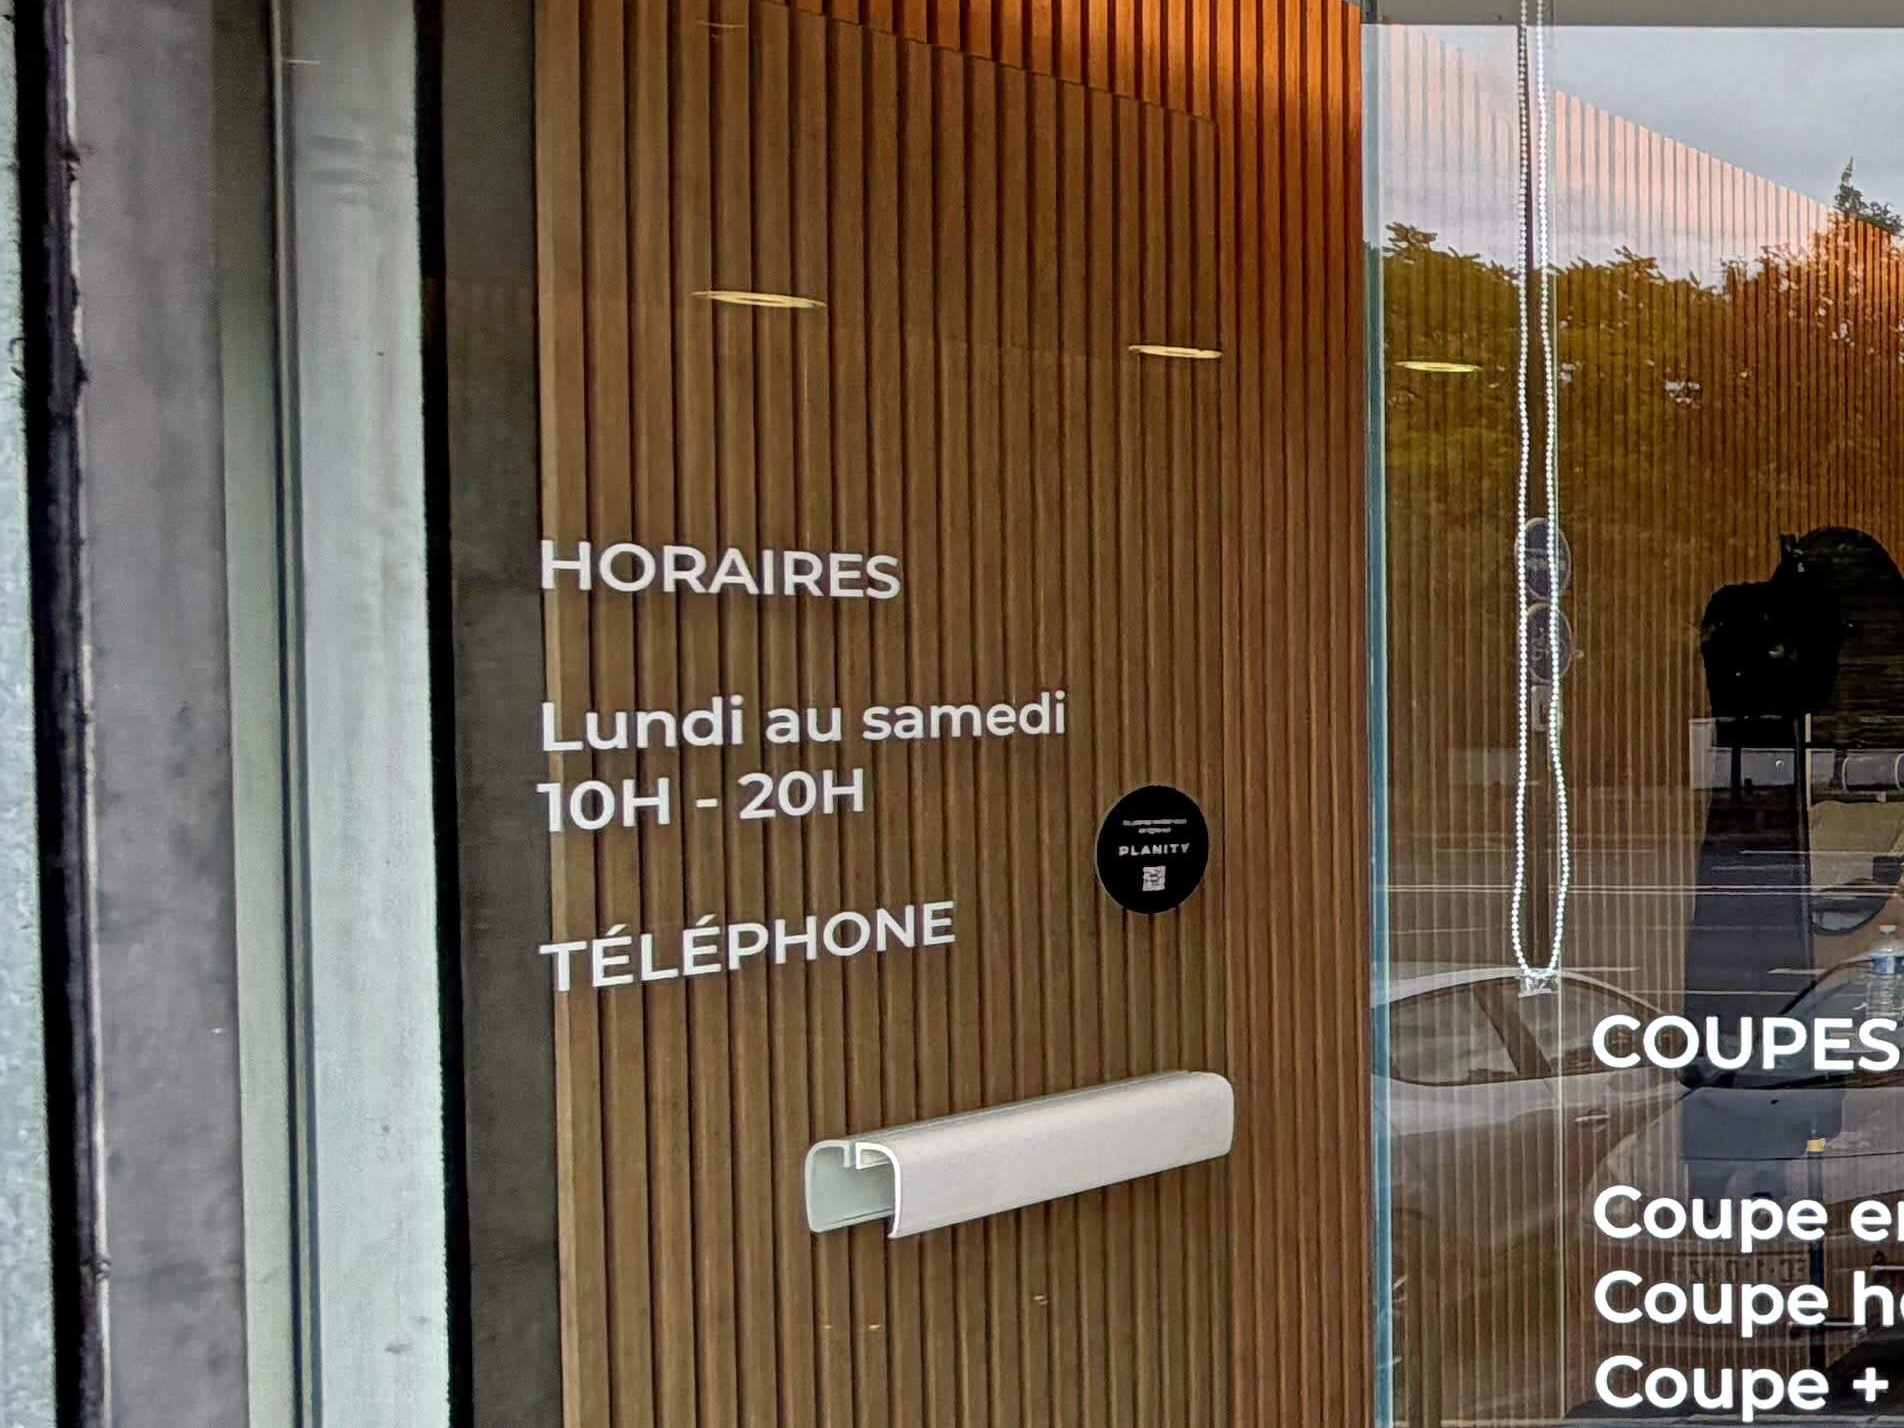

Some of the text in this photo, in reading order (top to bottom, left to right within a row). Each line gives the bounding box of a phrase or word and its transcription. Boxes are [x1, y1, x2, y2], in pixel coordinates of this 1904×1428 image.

[542, 540, 899, 599] HORAIRES
[542, 692, 1064, 752] Lundi au samedi
[537, 769, 863, 832] 10H - 20H
[1118, 842, 1191, 857] PLANITY
[539, 901, 955, 992] TÉLÉPHONE
[1592, 1014, 1900, 1072] COUPES
[1593, 1184, 1828, 1254] Coupe
[1594, 1270, 1829, 1338] Coupe
[1595, 1355, 1829, 1423] Coupe
[1852, 1368, 1889, 1402] +
